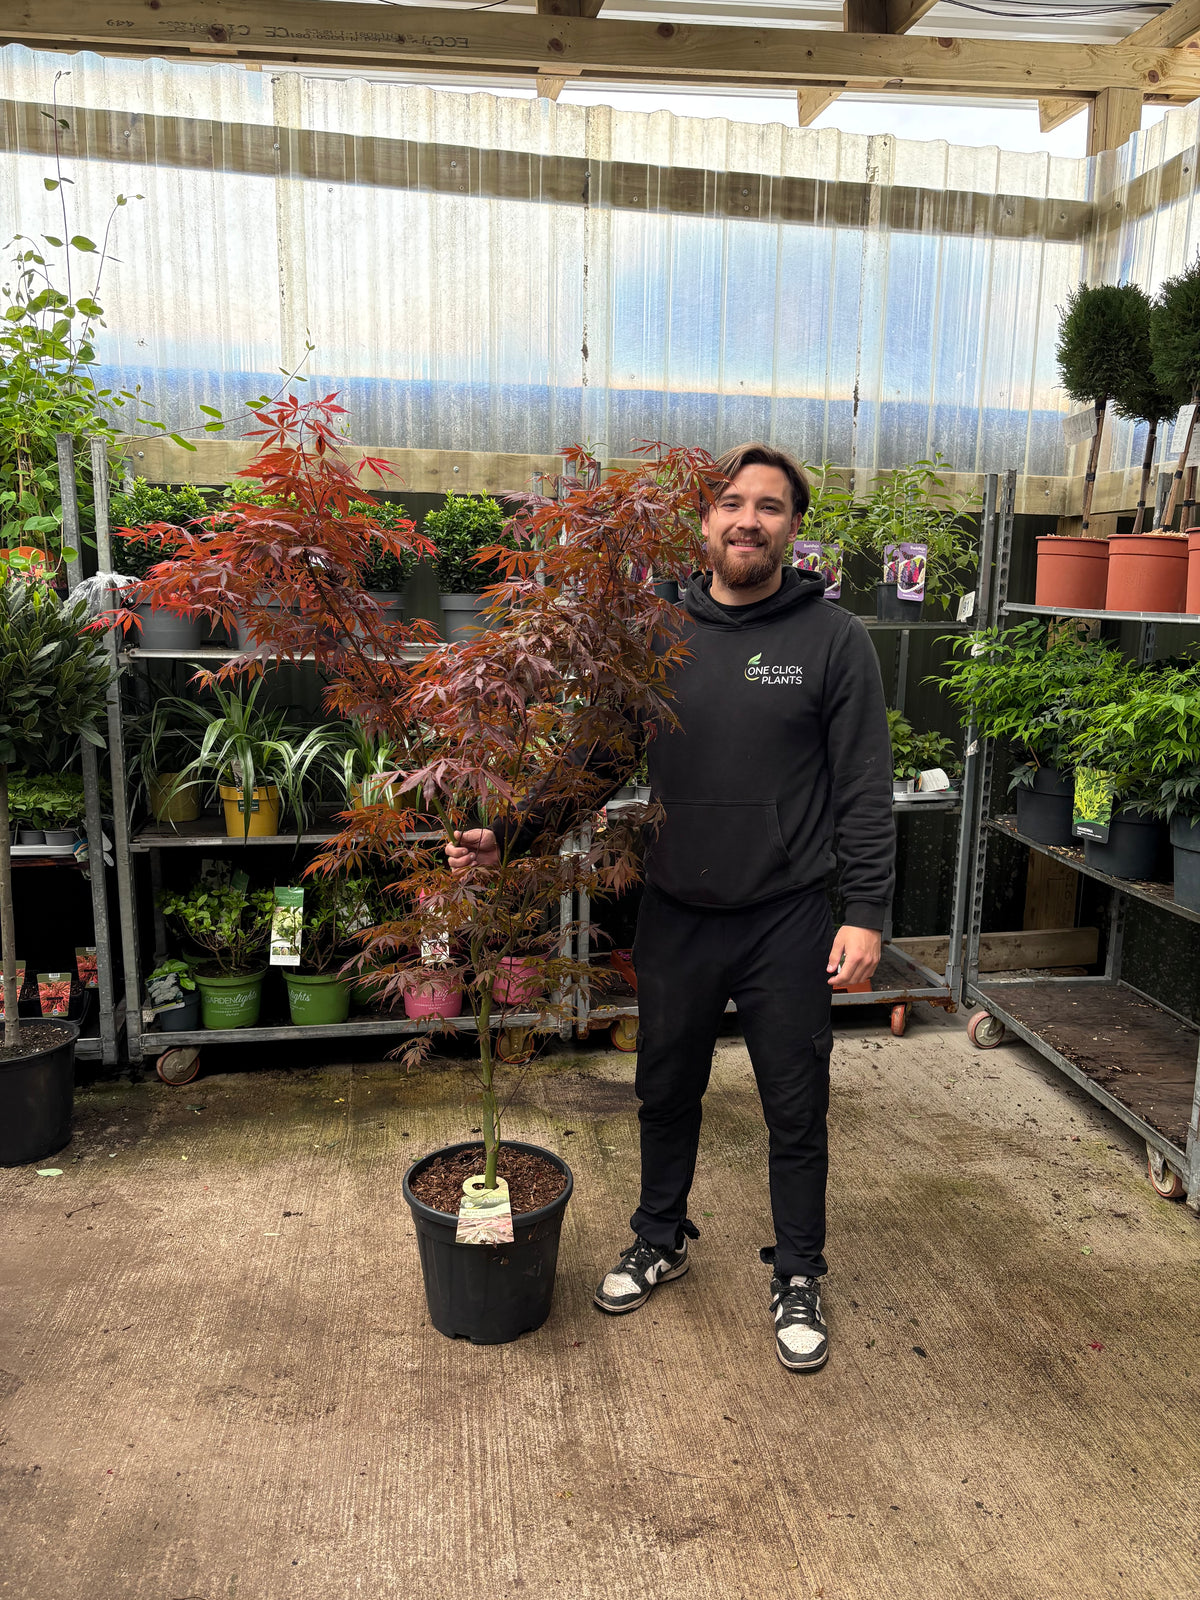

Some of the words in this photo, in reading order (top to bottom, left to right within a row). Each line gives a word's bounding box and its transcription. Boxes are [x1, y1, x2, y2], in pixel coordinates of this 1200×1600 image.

[748, 665, 770, 675] ONE
[772, 665, 803, 675] CLICK
[761, 676, 803, 685] PLANTS
